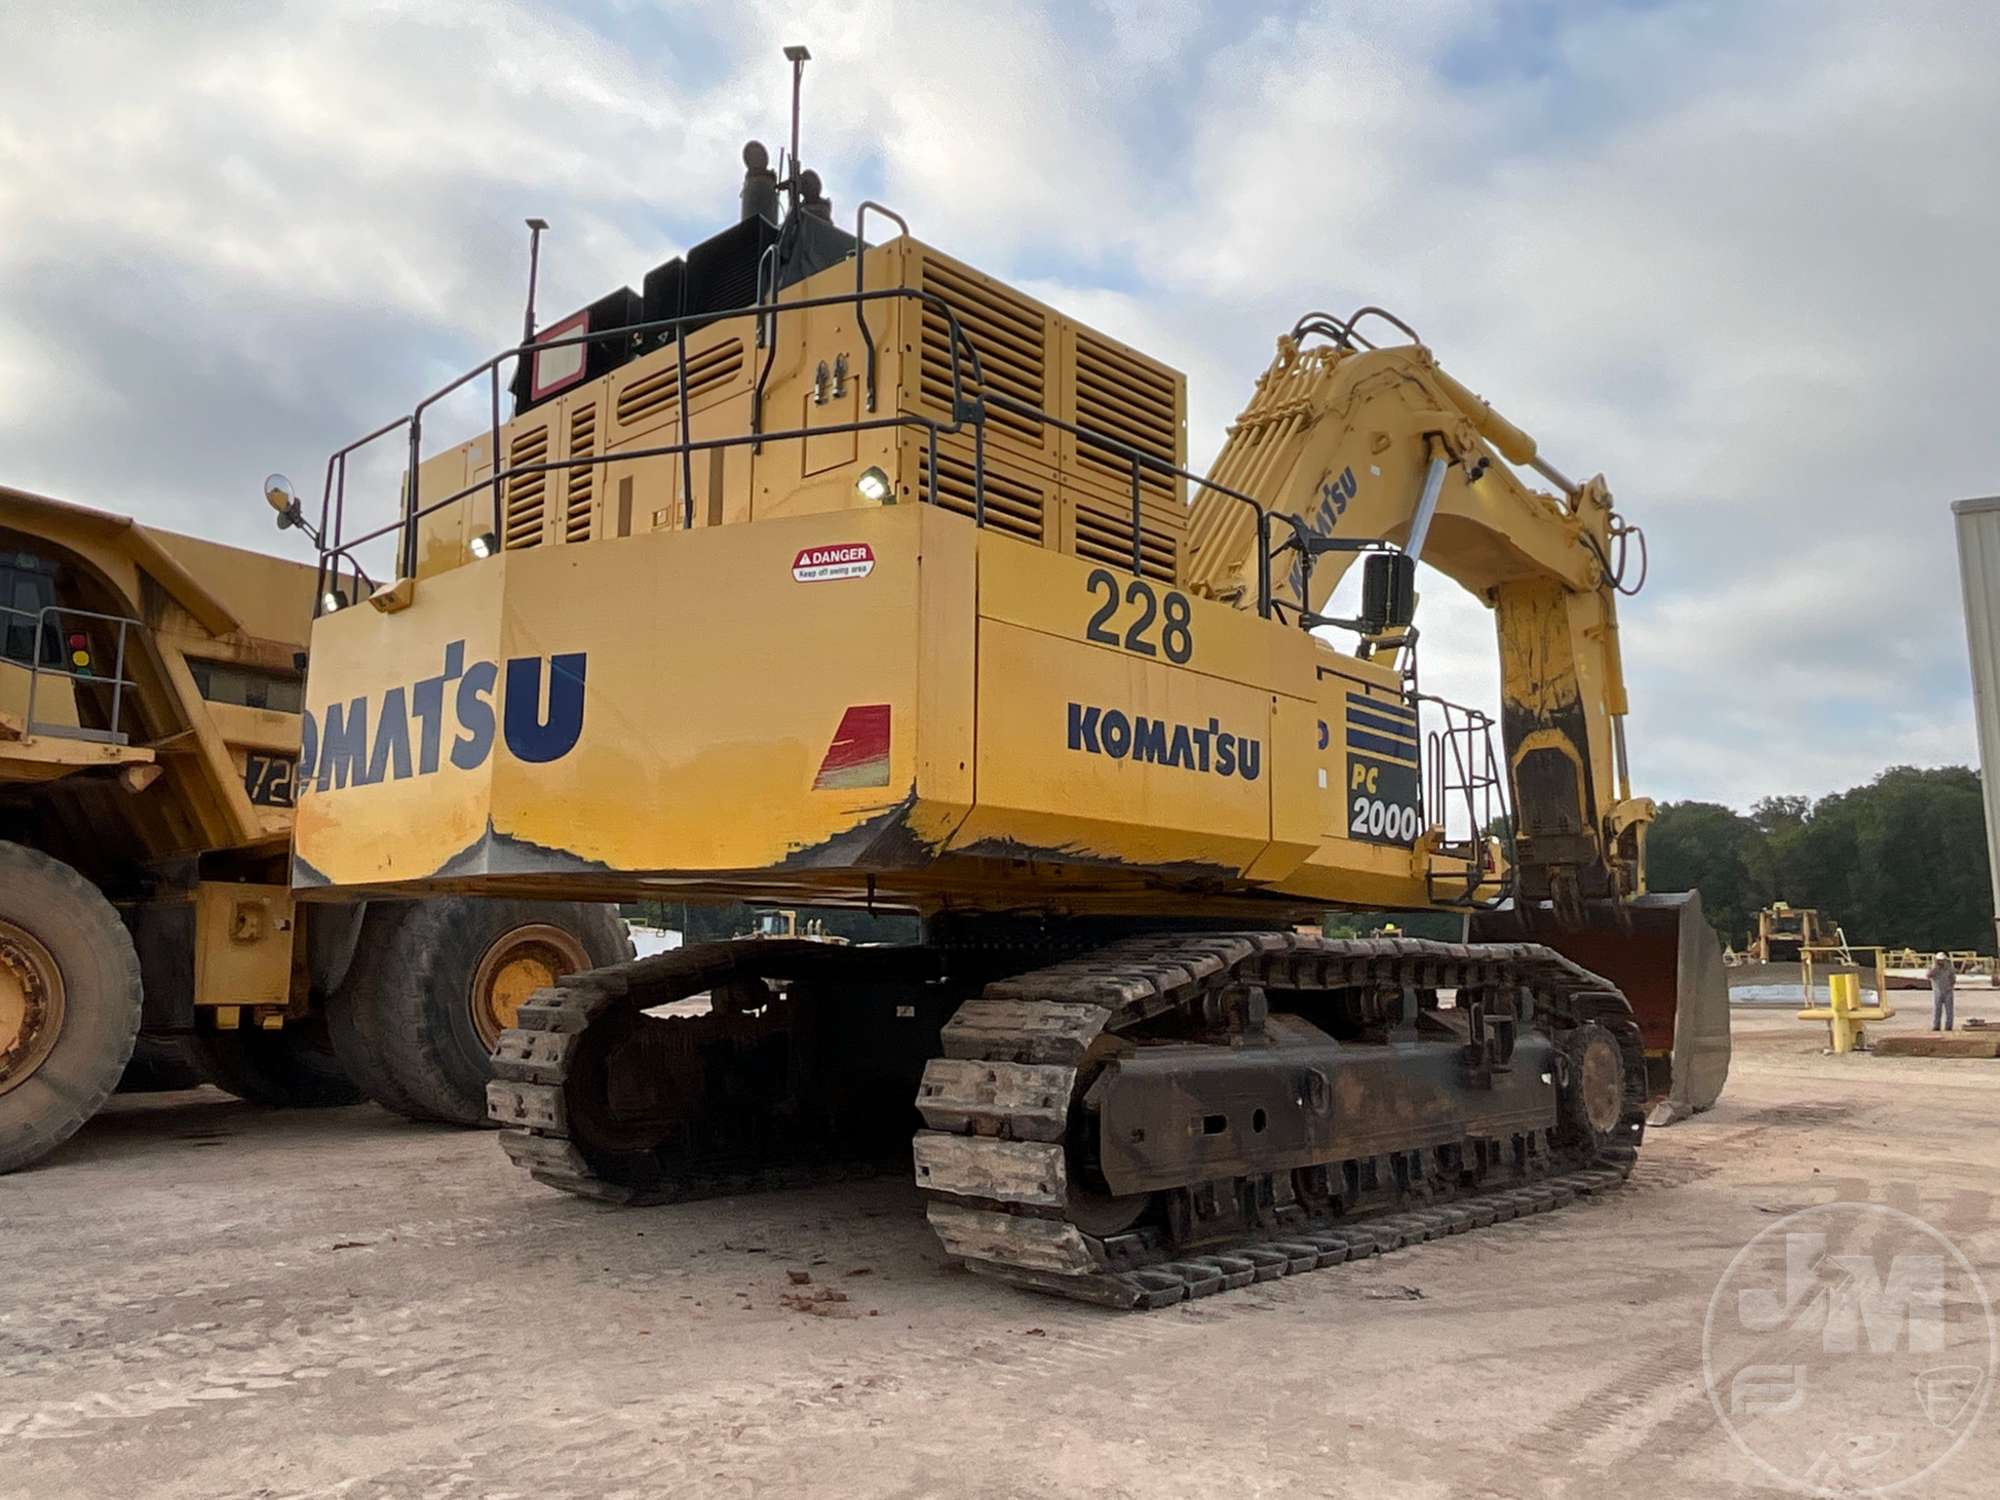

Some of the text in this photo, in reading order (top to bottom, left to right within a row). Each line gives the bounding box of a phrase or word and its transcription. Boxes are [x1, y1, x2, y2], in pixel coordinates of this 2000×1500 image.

[812, 547, 867, 564] DANGER
[1289, 465, 1357, 601] KATSU
[1086, 568, 1193, 665] 228
[1067, 701, 1261, 781] KOMATSU
[1351, 762, 1379, 795] PC
[1350, 796, 1417, 842] 2000
